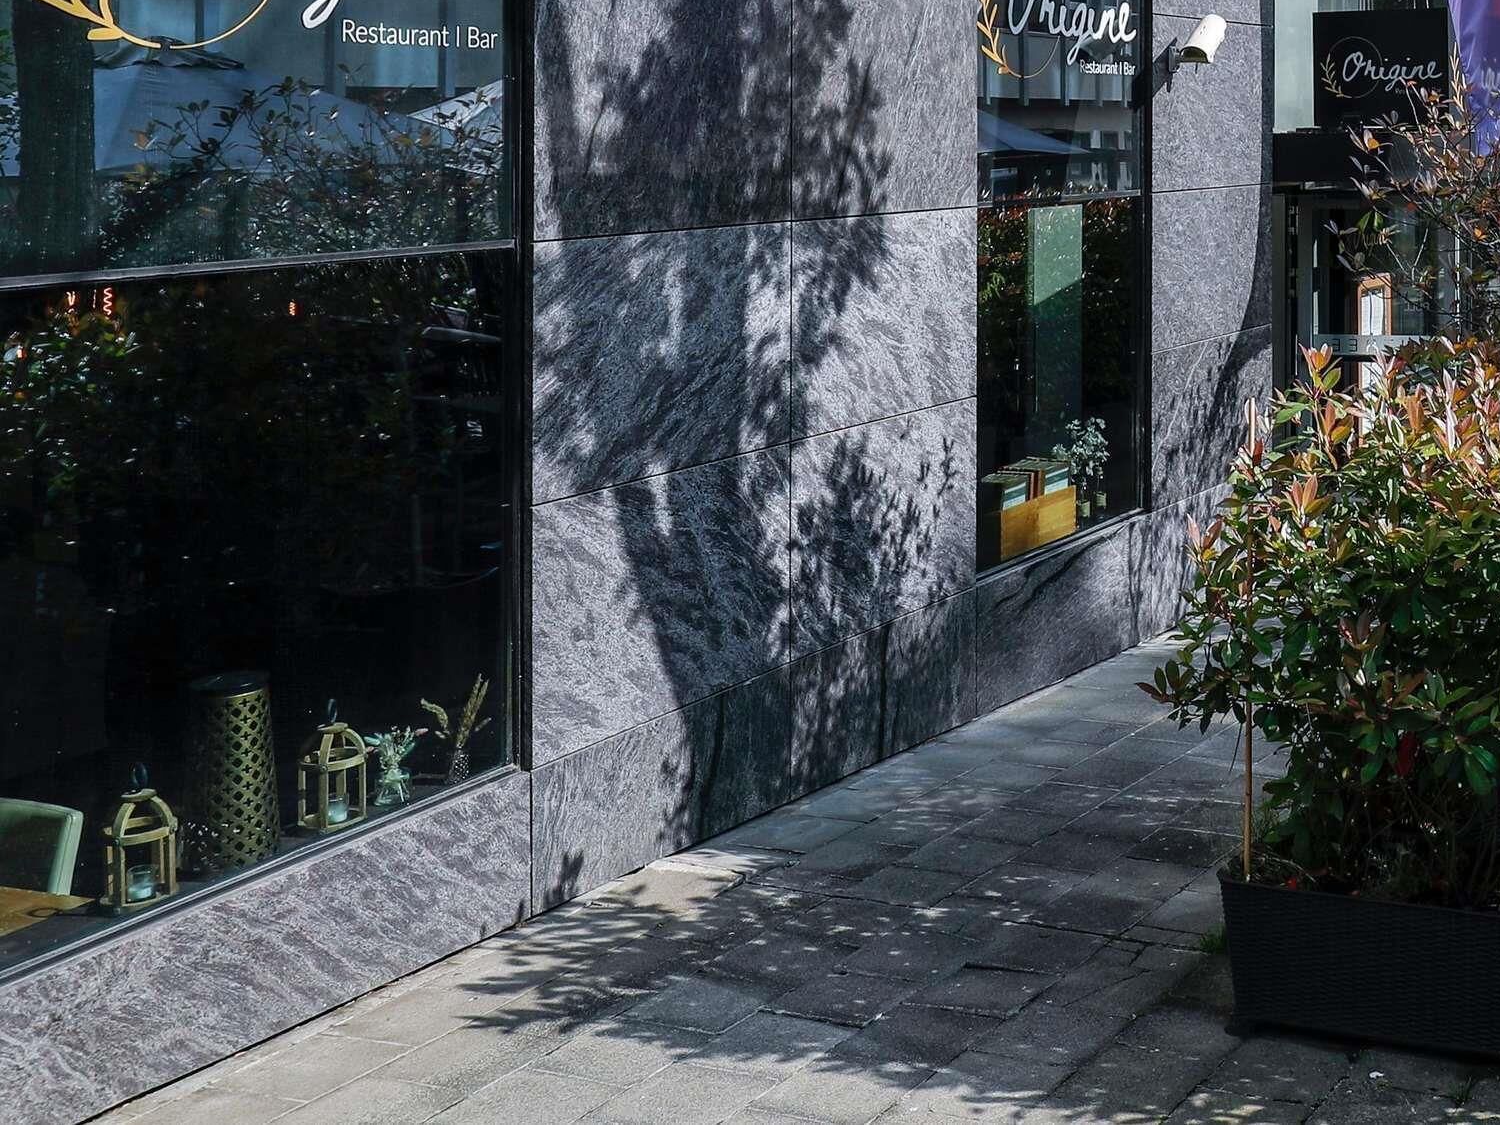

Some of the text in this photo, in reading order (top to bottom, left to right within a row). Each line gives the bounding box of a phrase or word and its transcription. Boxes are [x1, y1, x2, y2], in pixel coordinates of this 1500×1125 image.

[341, 18, 450, 47] Restaurant
[467, 26, 498, 49] Bar
[1079, 59, 1118, 75] Restaurant
[1123, 61, 1136, 76] Bar
[1342, 51, 1443, 92] Origine
